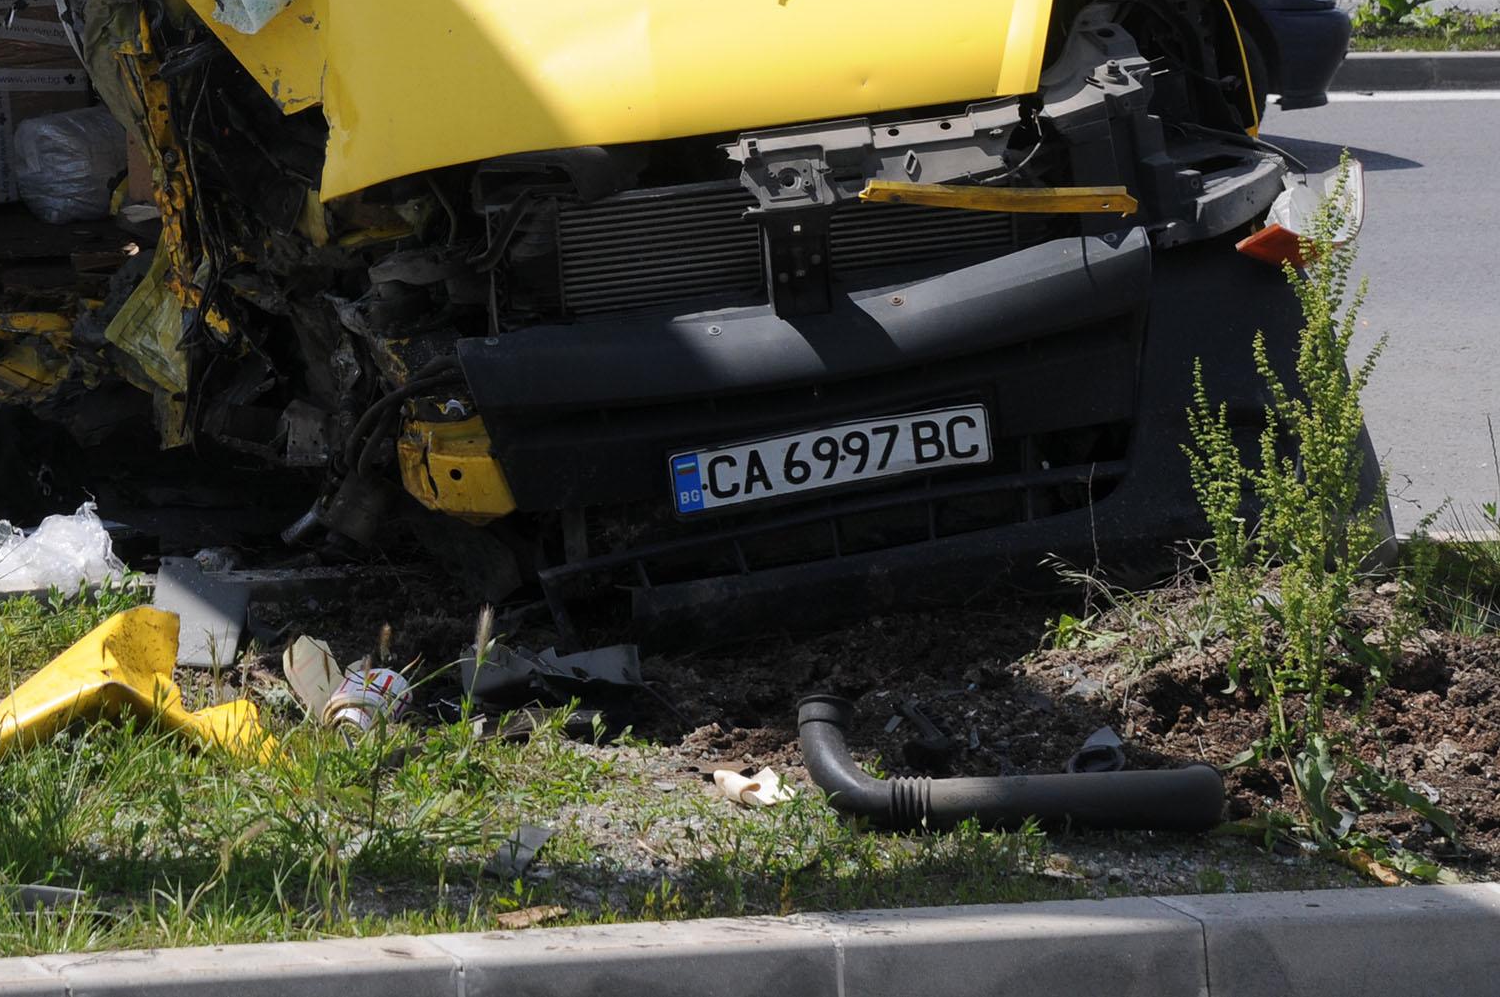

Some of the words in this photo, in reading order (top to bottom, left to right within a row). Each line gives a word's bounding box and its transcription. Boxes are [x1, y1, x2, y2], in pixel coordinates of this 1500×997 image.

[706, 450, 773, 499] CA
[783, 424, 900, 485] 6997
[910, 415, 980, 465] BC
[679, 490, 701, 504] BG
